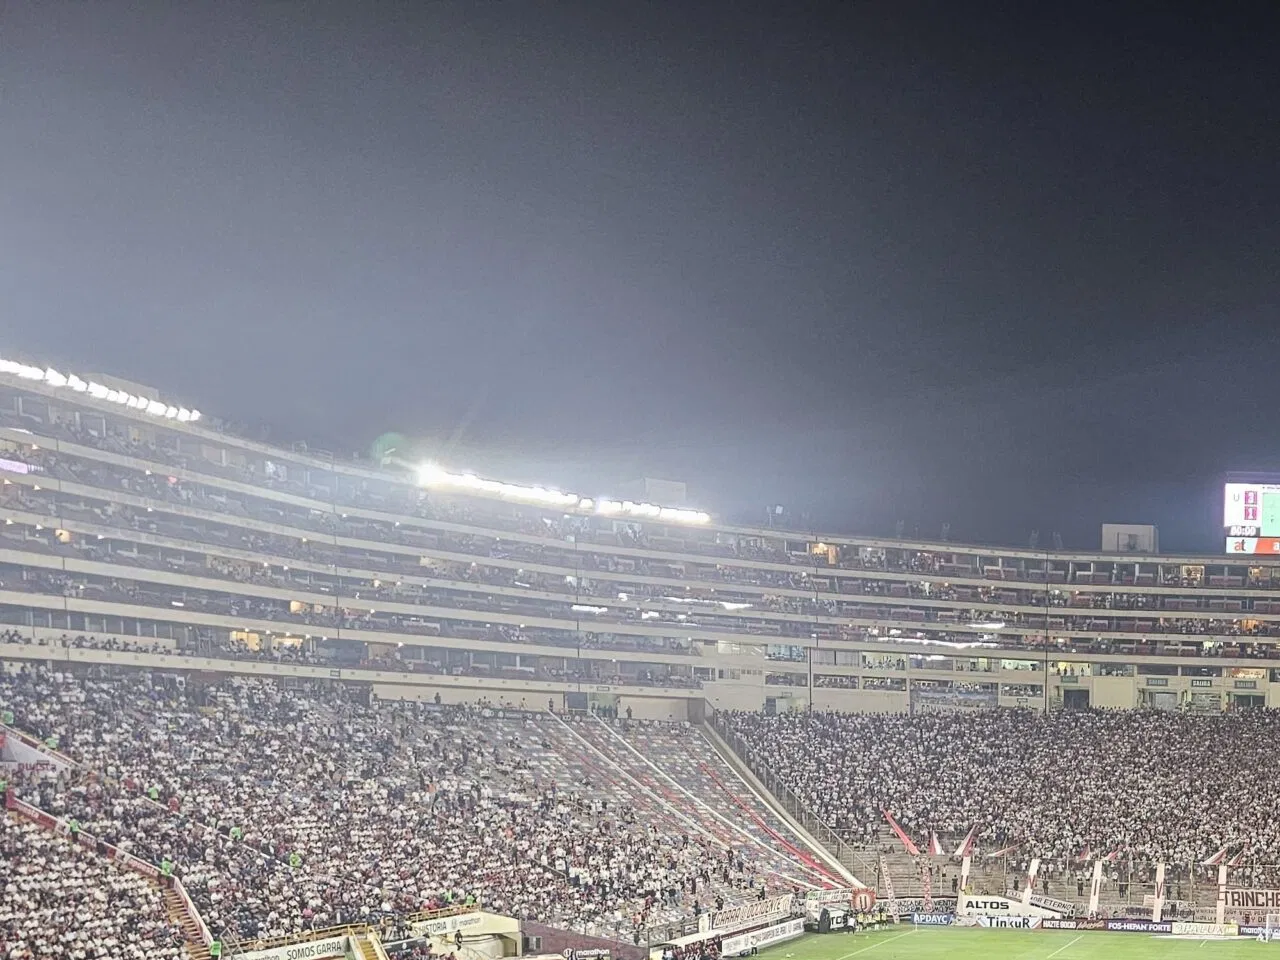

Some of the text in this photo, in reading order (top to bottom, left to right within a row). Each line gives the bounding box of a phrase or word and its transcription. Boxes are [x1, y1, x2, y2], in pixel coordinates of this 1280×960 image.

[966, 901, 1009, 909] ALTOS
[287, 946, 315, 960] SOMOS
[317, 941, 341, 954] GARRA
